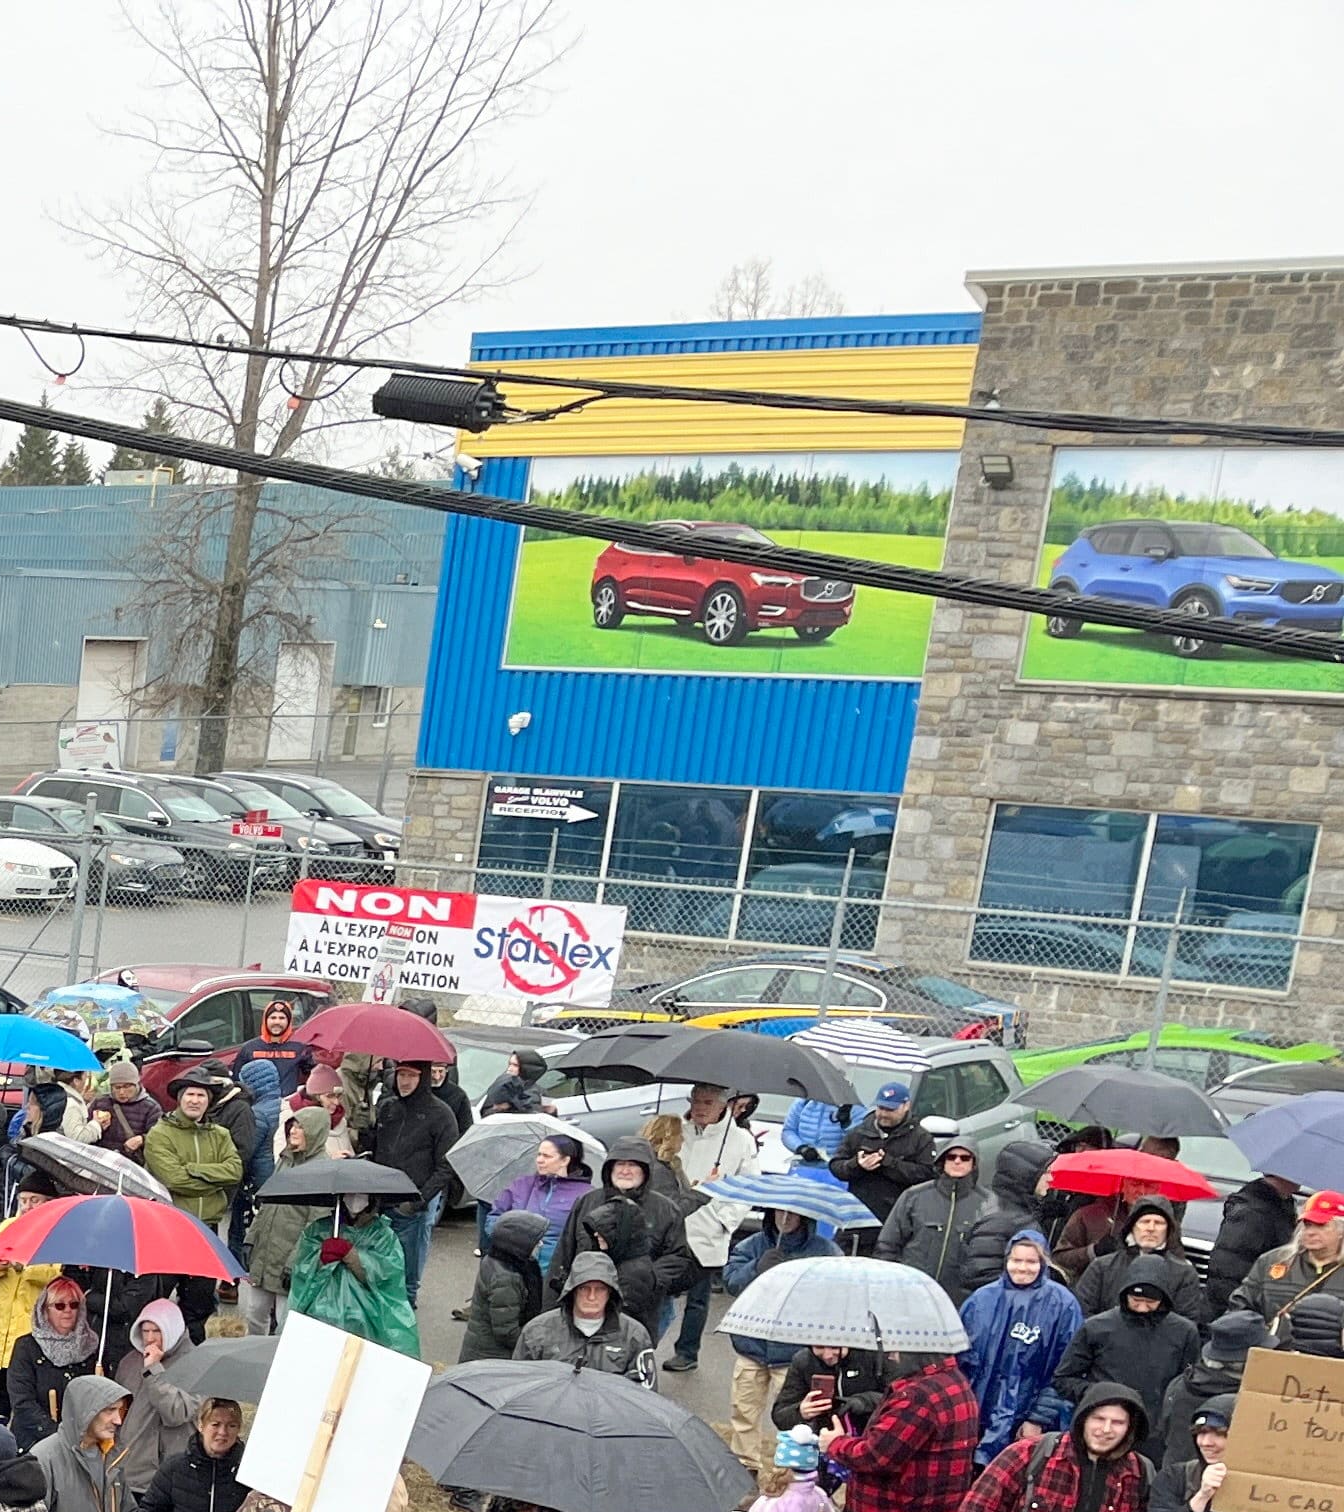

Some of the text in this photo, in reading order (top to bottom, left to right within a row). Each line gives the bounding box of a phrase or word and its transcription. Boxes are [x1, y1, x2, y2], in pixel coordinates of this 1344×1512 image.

[531, 797, 569, 806] VOLVO
[315, 887, 451, 922] NON
[320, 919, 439, 945] À L'EXPAON
[474, 926, 616, 971] Stablex
[299, 934, 309, 952] À
[314, 941, 455, 968] L'EXPROATION
[288, 957, 460, 989] À LA CONTNATION
